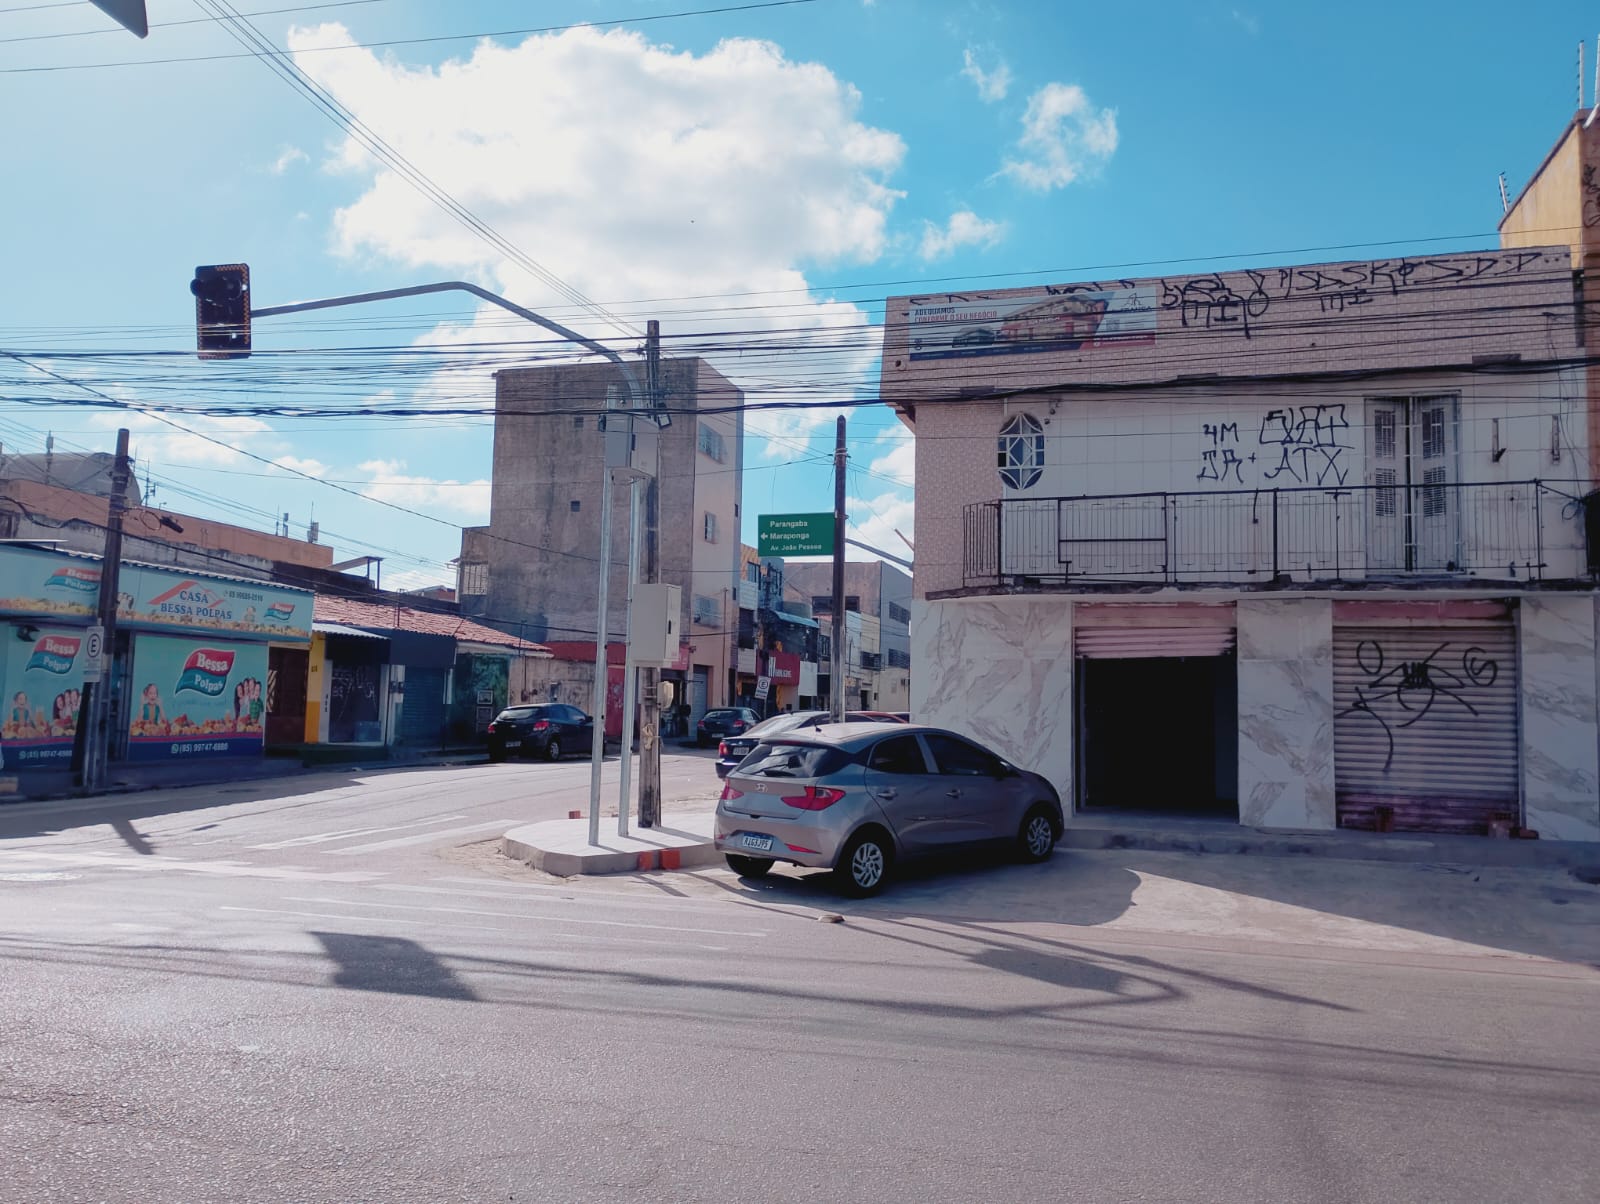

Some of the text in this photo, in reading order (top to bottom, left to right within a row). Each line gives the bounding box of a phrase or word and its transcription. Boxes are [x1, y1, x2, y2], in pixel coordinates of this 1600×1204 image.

[769, 520, 808, 529] Parangaba
[769, 532, 810, 541] Maraponga
[781, 543, 797, 551] João
[798, 543, 822, 551] Pessoa
[180, 590, 209, 604] CASA
[160, 602, 232, 620] BESSA POLPAS
[45, 638, 75, 654] Bessa
[90, 639, 97, 653] E
[196, 652, 228, 671] Bessa
